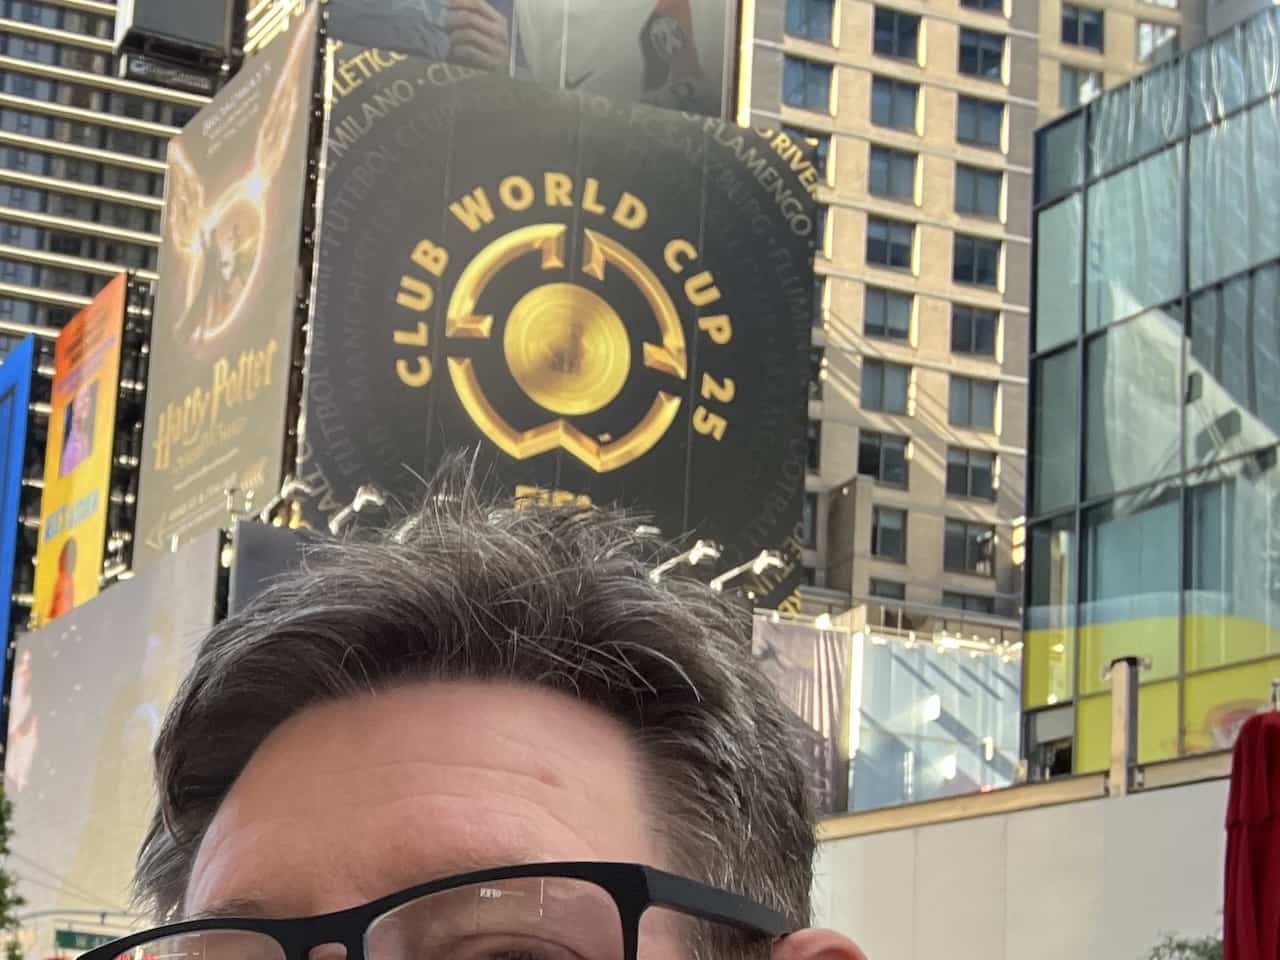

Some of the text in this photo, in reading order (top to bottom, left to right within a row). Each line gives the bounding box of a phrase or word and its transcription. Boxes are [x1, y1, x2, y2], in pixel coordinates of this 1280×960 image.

[327, 79, 415, 157] MILANO
[449, 171, 648, 233] WORLD
[702, 117, 814, 237] FLAMENGO
[392, 239, 450, 388] CLUB
[662, 238, 732, 346] CUP
[153, 385, 211, 472] Harry
[210, 337, 278, 428] Potter
[692, 372, 736, 443] 25
